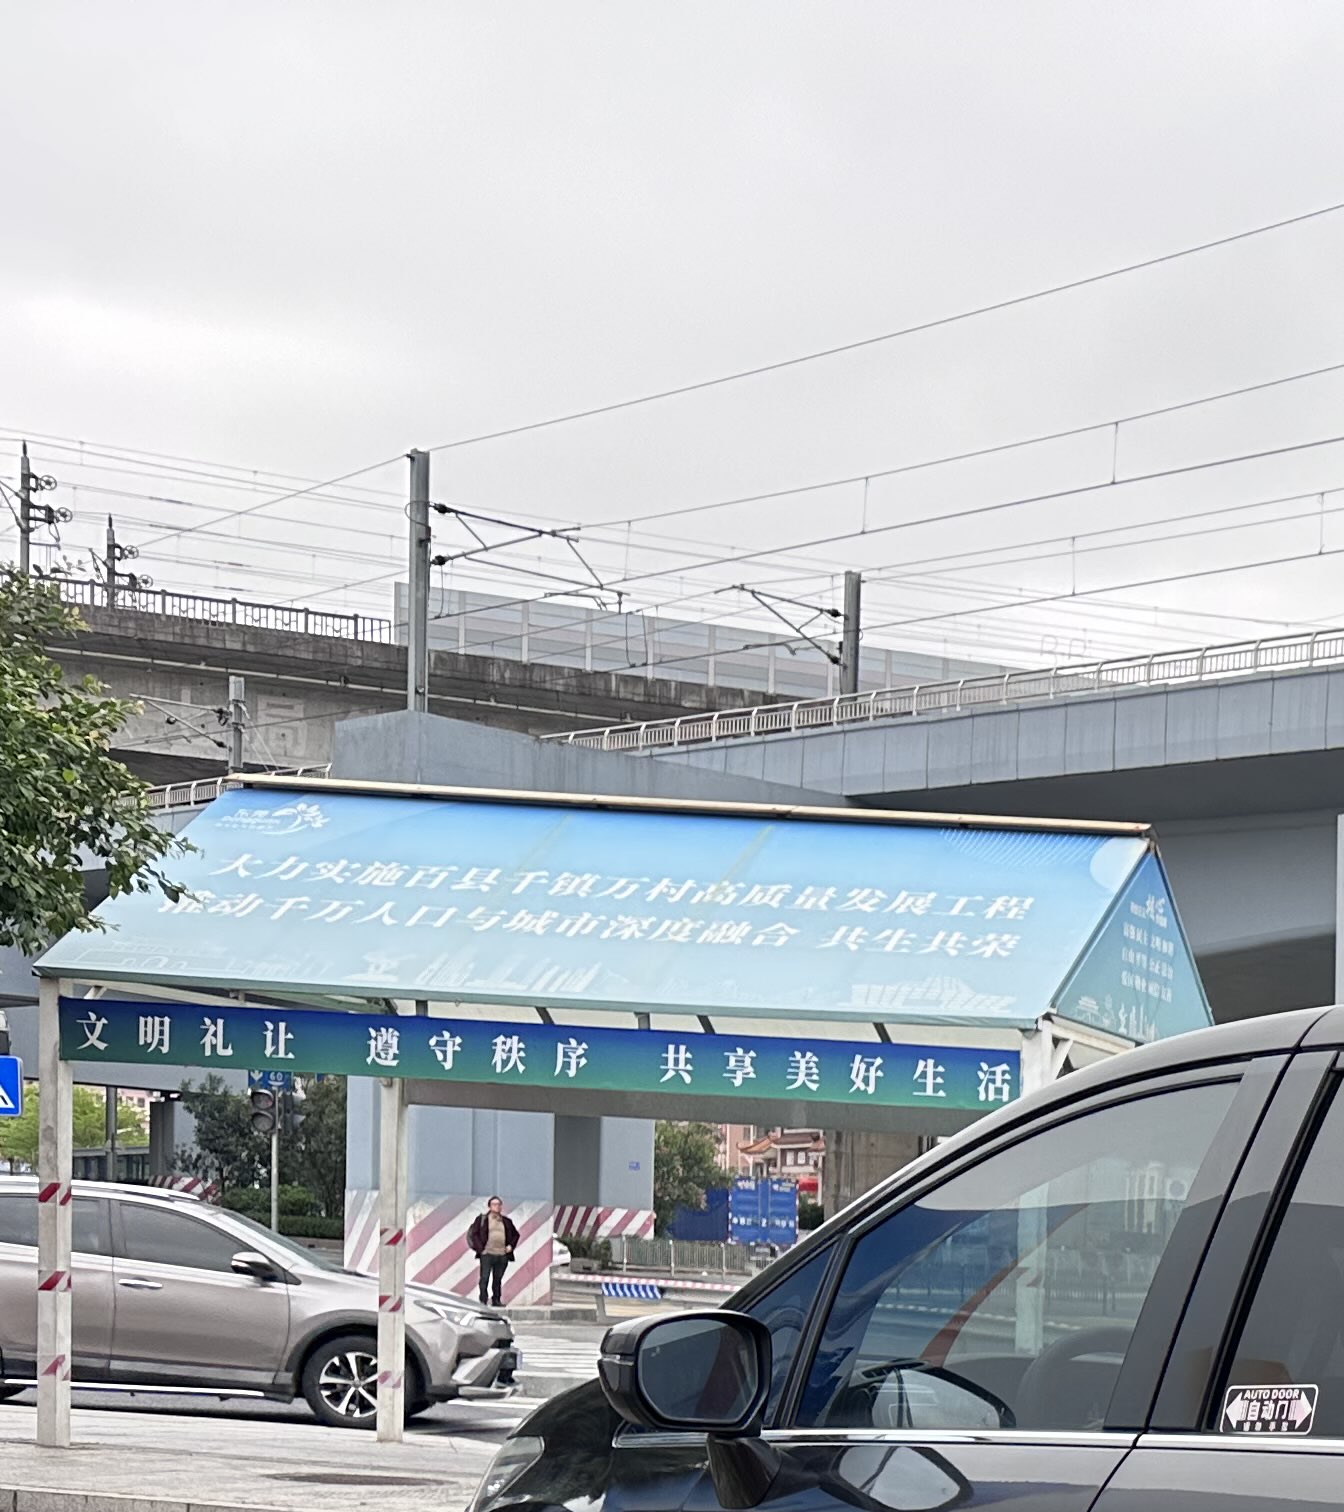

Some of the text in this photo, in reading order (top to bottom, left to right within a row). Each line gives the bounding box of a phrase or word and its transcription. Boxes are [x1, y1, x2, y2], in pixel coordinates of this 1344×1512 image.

[207, 852, 1036, 921] 大力实施百县千镇万村高质量发展工程
[815, 926, 1023, 959] 共生共荣
[76, 1010, 1013, 1103] 文明礼让 遵守秩序 共享美好生活
[269, 1071, 283, 1081] 60
[1243, 1389, 1300, 1400] AUTO DOOR
[1247, 1400, 1289, 1420] 自动门
